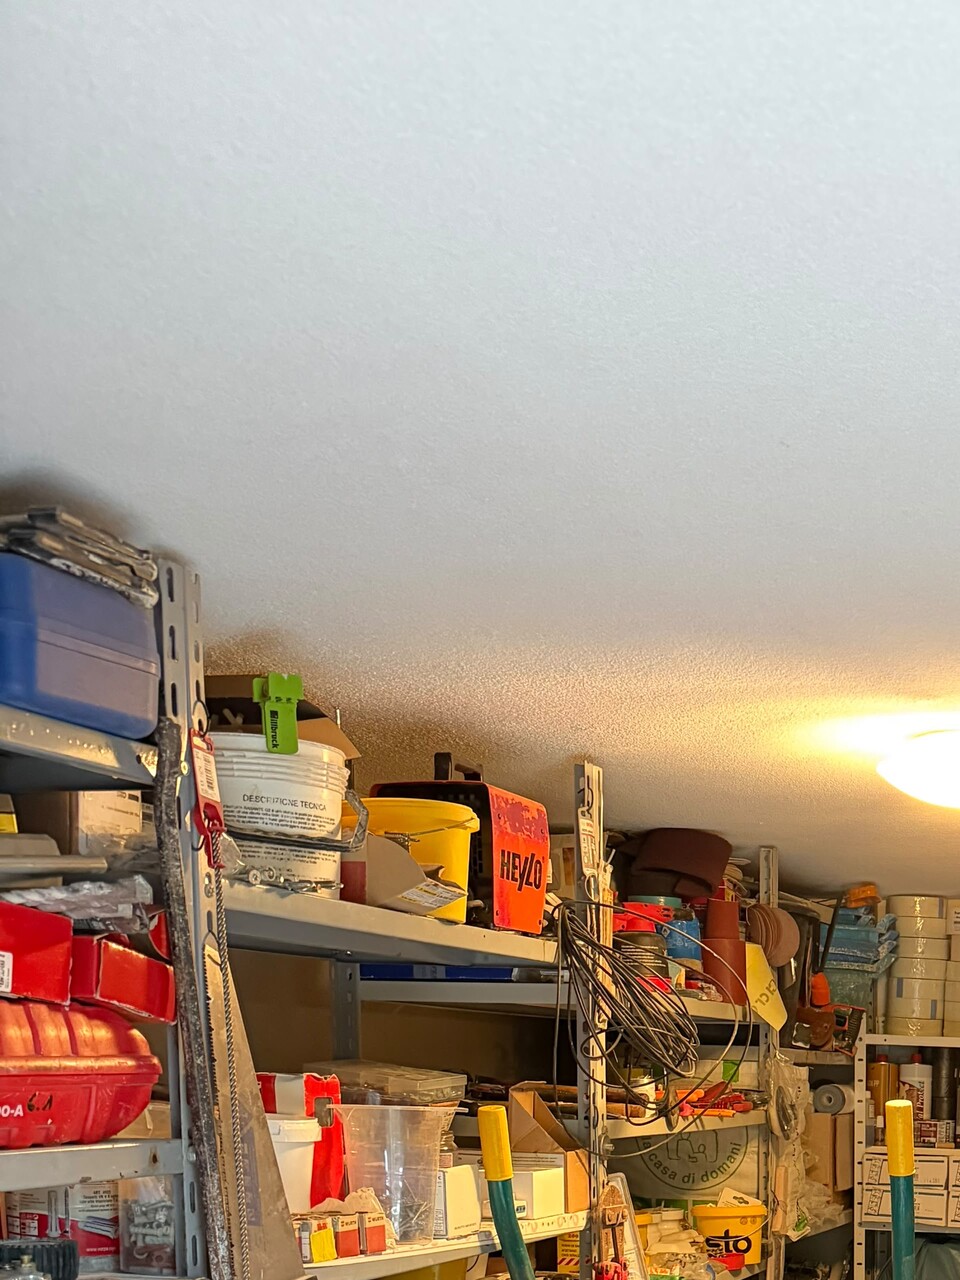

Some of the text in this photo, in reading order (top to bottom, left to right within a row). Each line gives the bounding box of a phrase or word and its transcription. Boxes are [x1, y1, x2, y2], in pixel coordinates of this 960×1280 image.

[500, 849, 543, 892] HEYLO
[0, 1104, 24, 1117] 0-A
[648, 1153, 676, 1180] casa
[682, 1172, 696, 1184] di
[701, 1141, 742, 1184] domani
